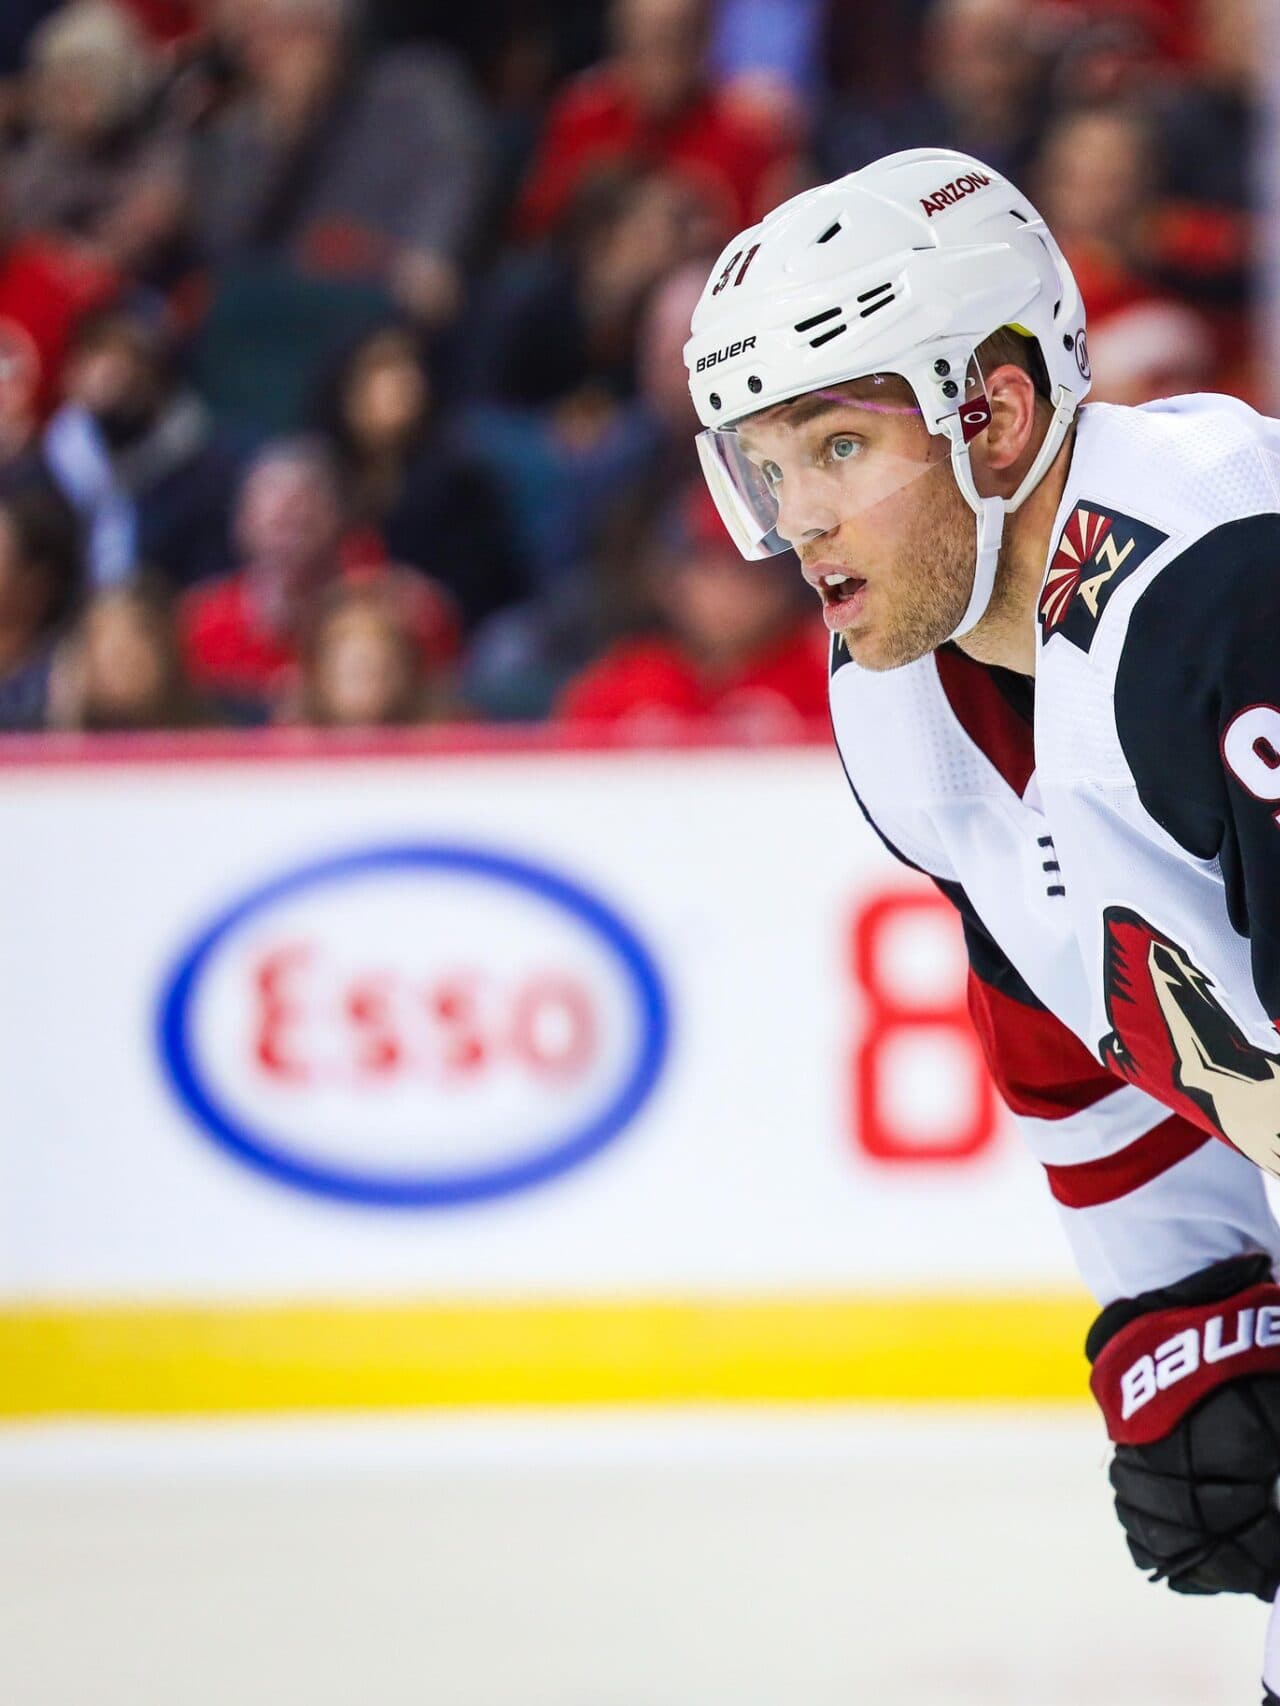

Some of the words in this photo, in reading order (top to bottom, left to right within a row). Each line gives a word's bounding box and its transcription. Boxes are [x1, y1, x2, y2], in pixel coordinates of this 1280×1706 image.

[696, 335, 757, 373] BAUER
[1076, 533, 1136, 619] AZ
[250, 936, 596, 1086] Esso
